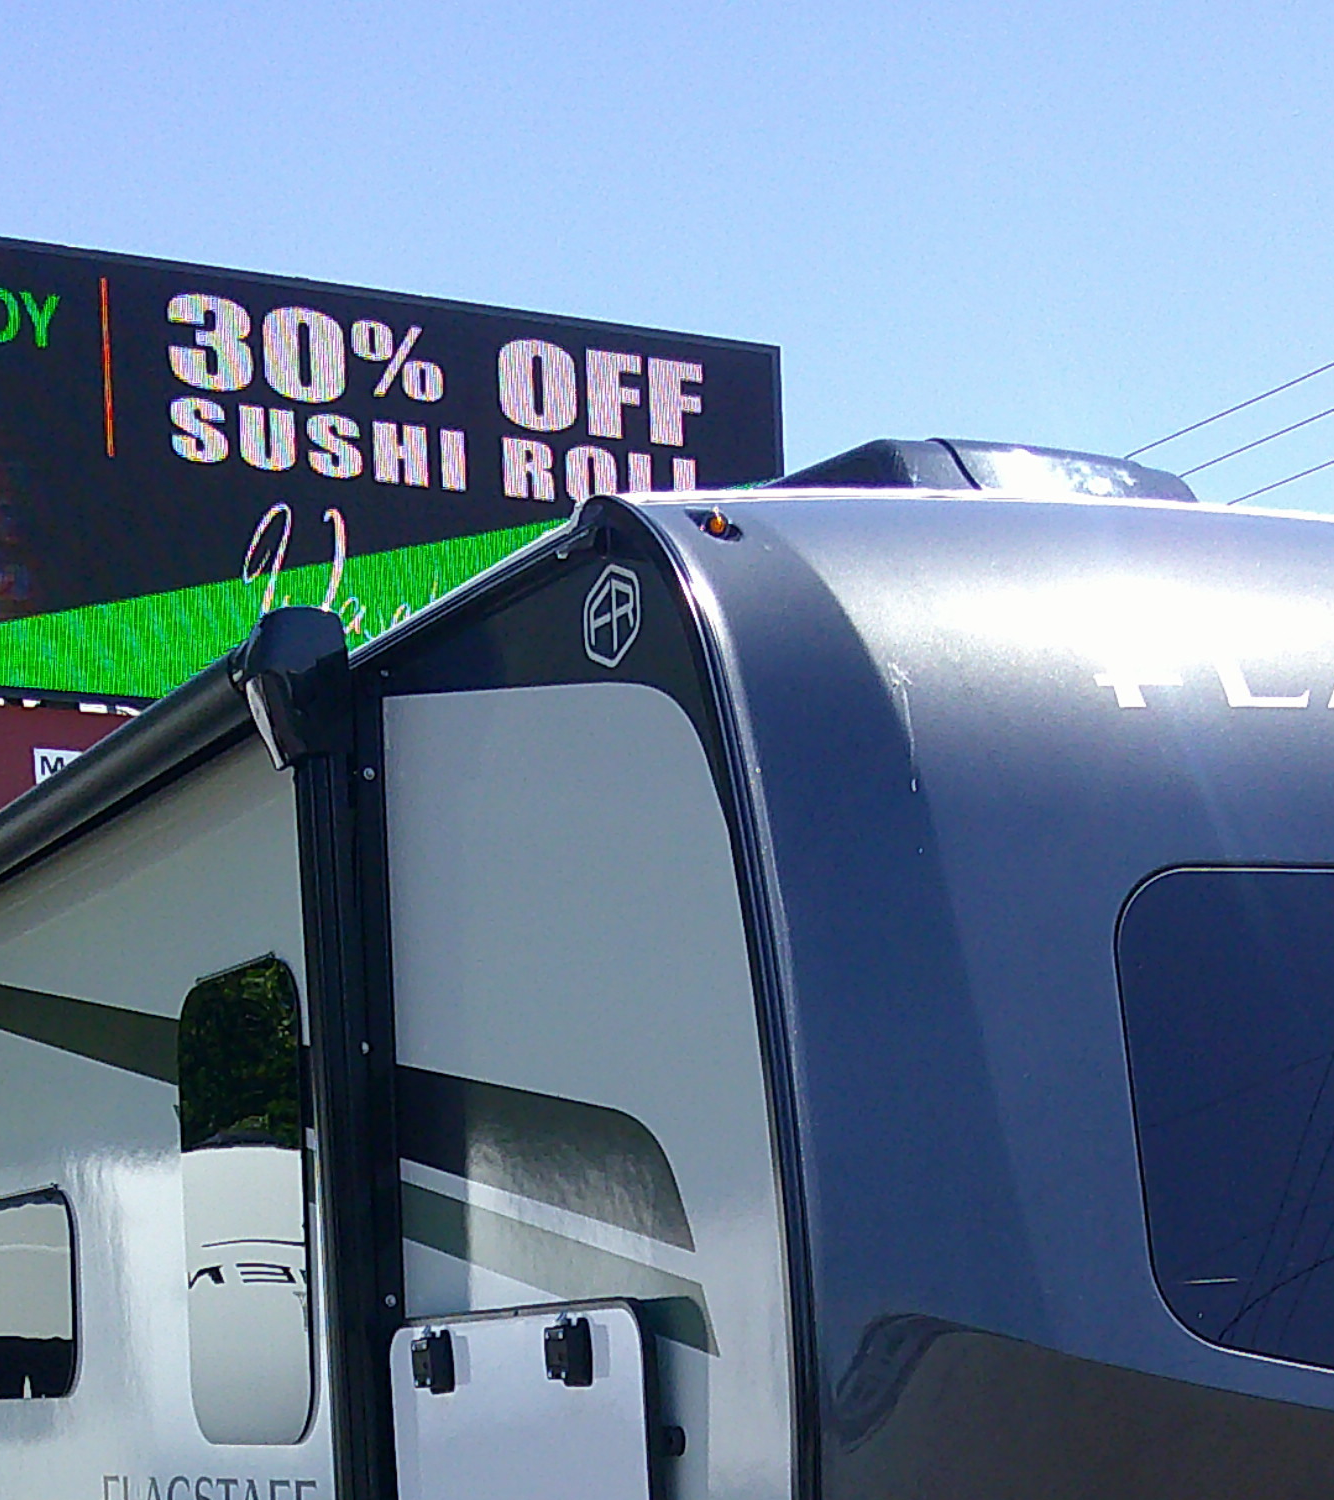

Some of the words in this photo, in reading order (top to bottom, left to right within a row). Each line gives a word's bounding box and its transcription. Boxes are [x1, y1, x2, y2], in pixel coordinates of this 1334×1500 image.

[167, 293, 445, 404] 30%
[498, 339, 704, 447] OFF
[169, 397, 467, 493] SUSHI
